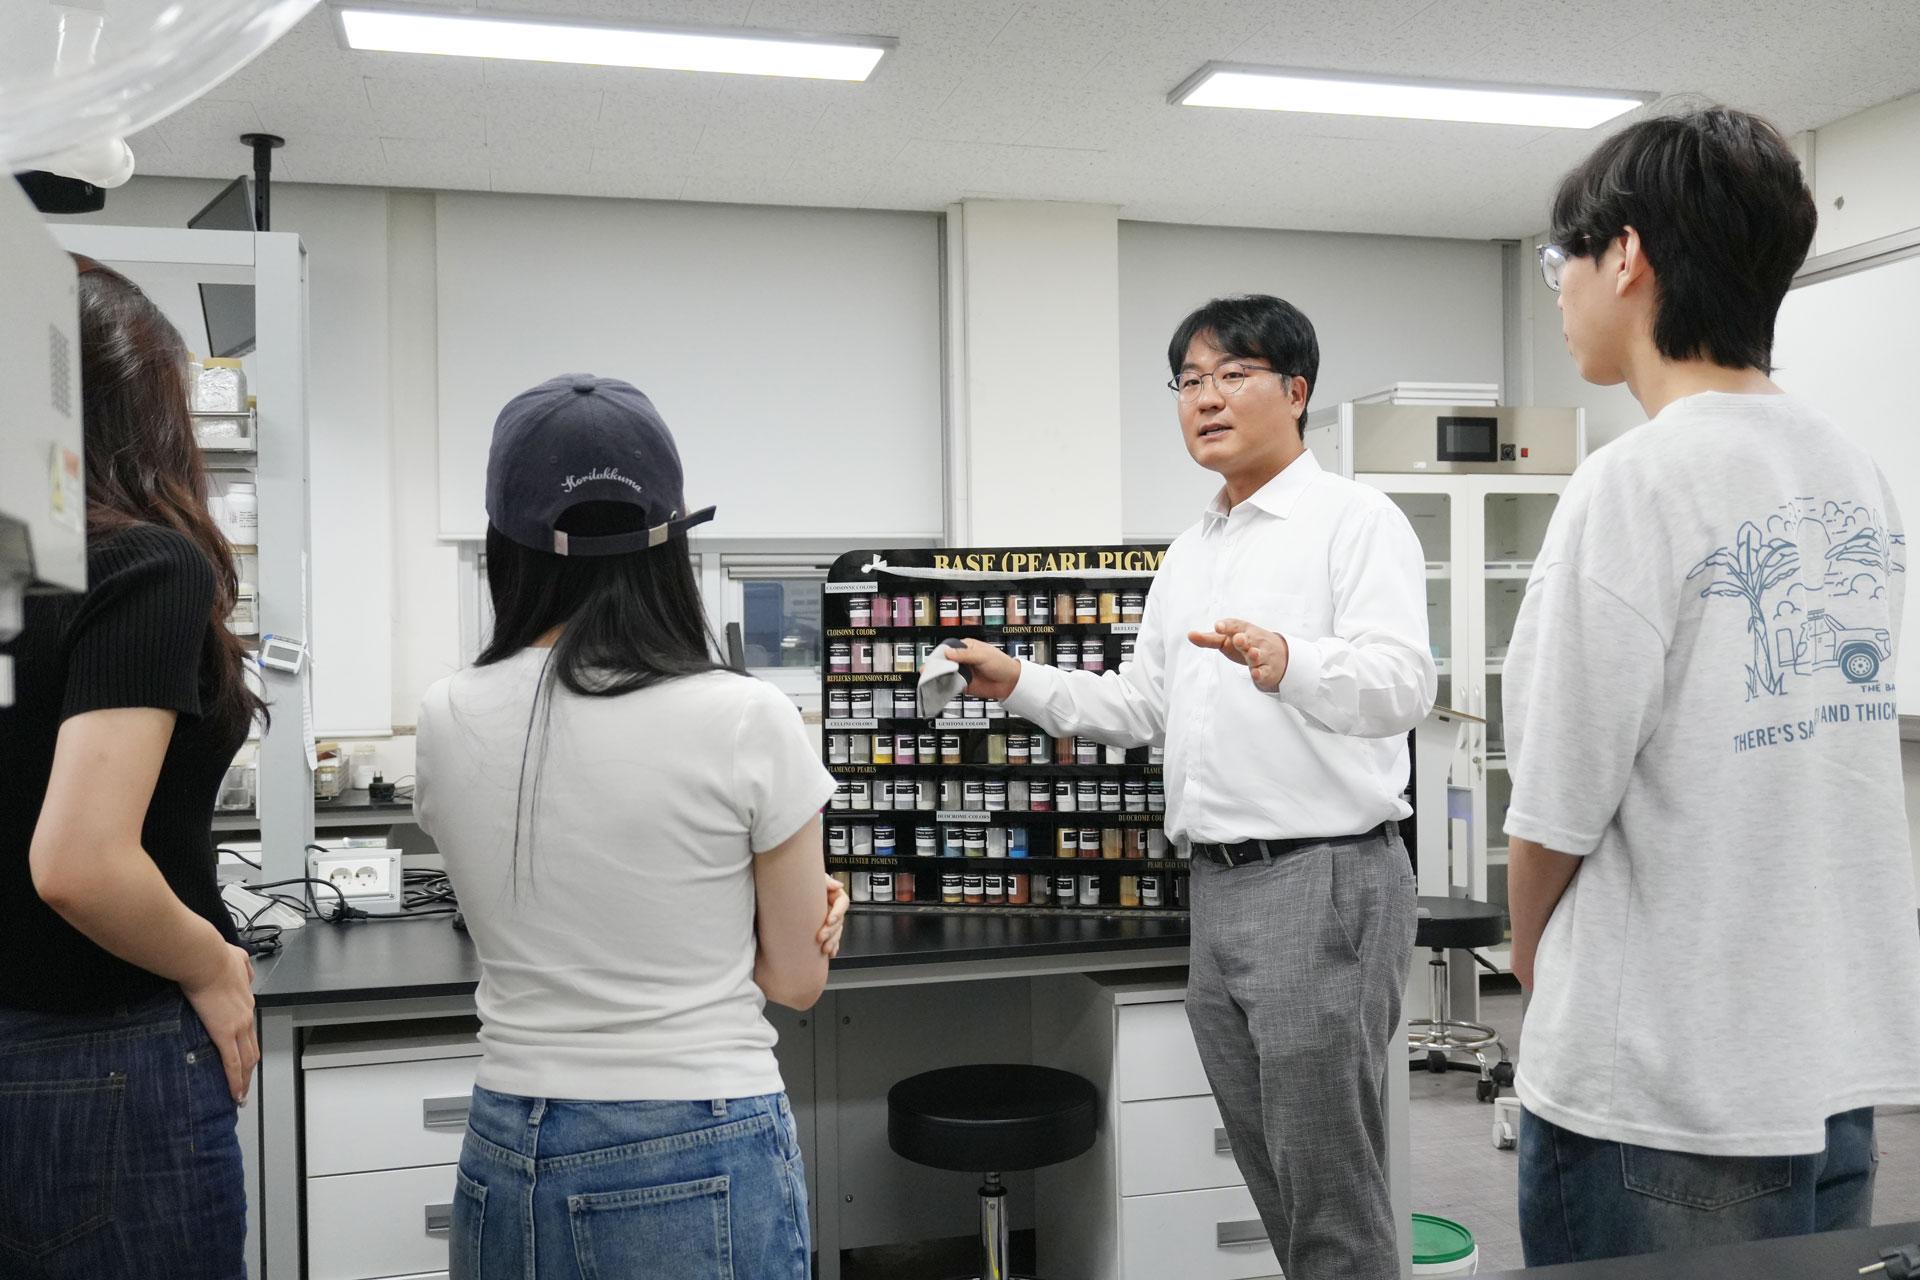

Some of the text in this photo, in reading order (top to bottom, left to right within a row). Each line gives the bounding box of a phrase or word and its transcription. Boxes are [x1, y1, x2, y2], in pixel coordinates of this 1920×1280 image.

[856, 628, 877, 636] COLORS
[1033, 625, 1055, 633] COLORS
[827, 674, 902, 682] REFLECKS DIMENSIONS PEARLS
[1861, 684, 1881, 693] THE
[1734, 724, 1794, 753] THERE'S
[1820, 703, 1850, 723] AND
[849, 857, 869, 865] LUSTER
[871, 857, 898, 866] PIGMENTS
